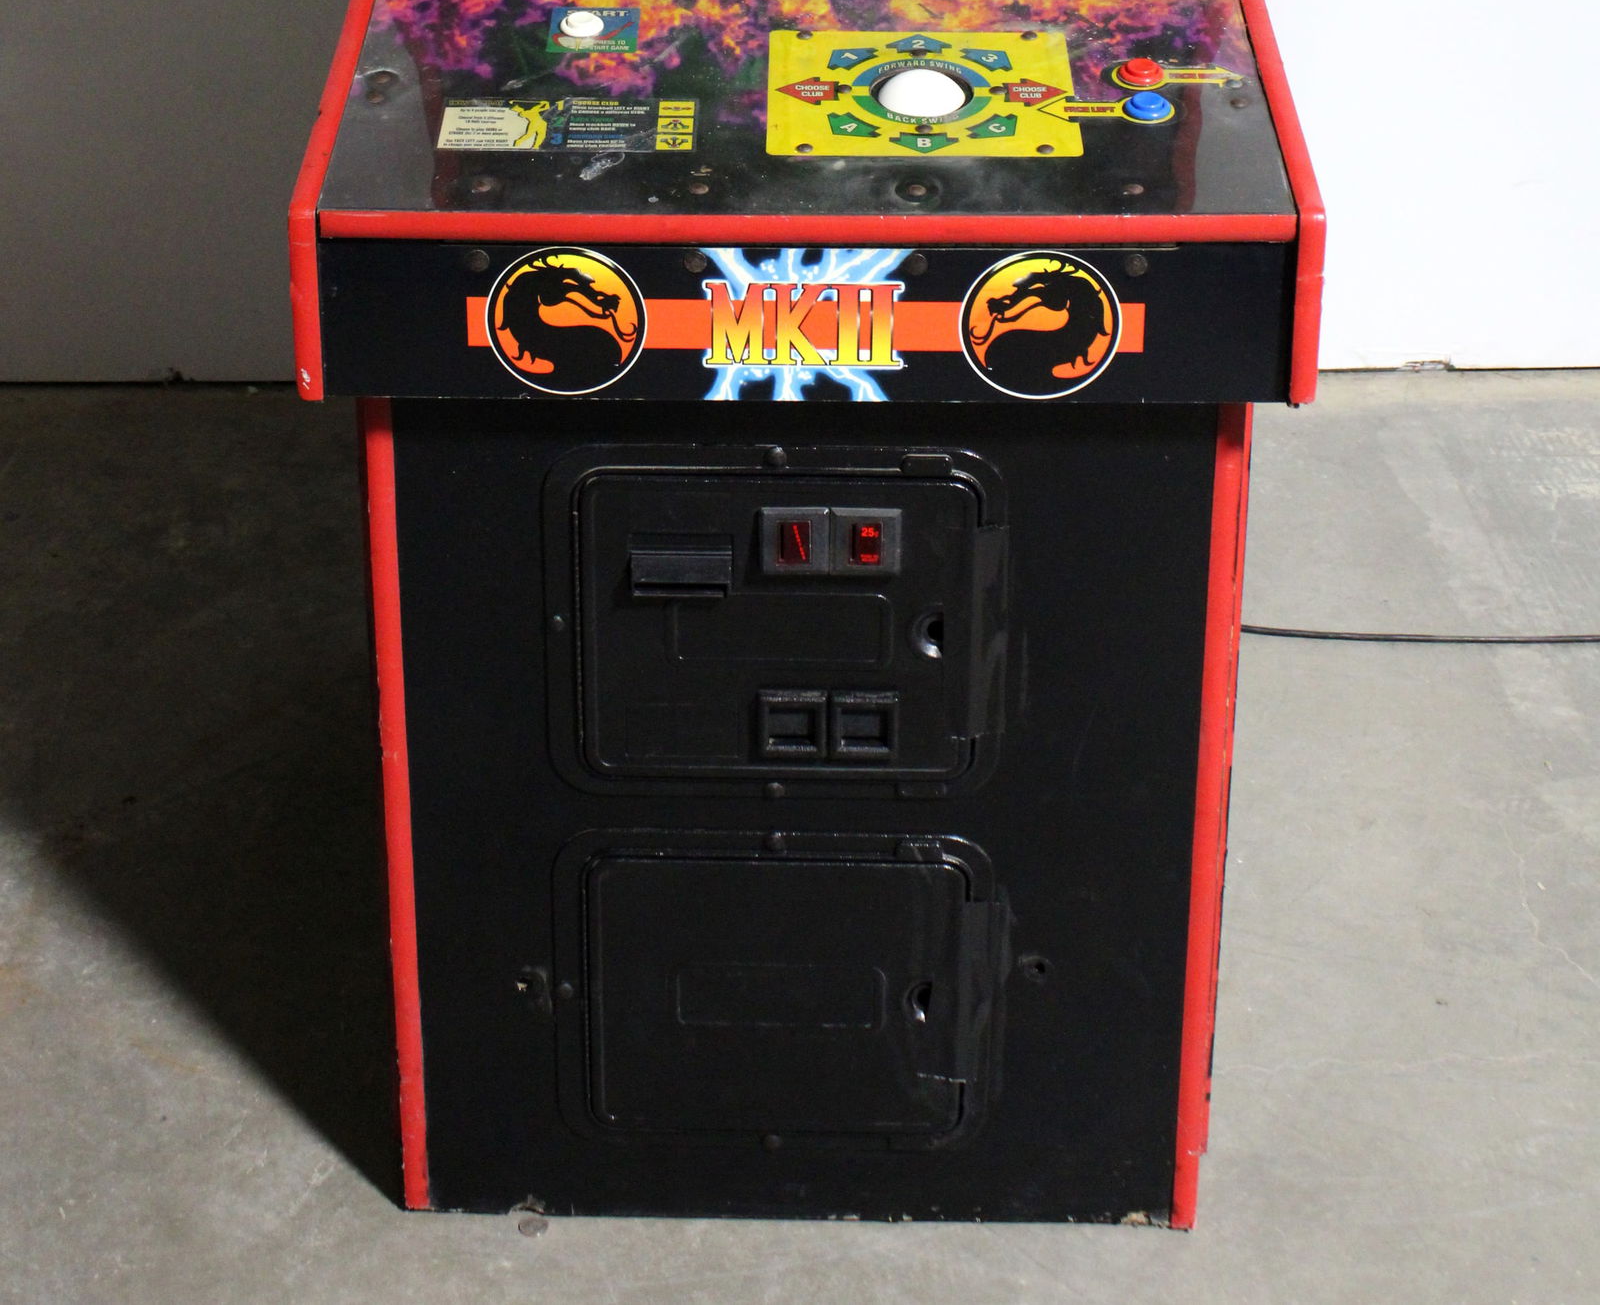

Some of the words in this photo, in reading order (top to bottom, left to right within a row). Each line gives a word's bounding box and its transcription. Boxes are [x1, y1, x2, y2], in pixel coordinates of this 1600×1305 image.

[566, 9, 629, 17] SART
[911, 39, 925, 49] 2
[841, 52, 858, 60] 1
[981, 53, 998, 63] 3
[878, 60, 926, 74] FORWARD
[929, 61, 962, 75] SWING
[555, 100, 565, 111] 1
[886, 112, 916, 124] BACK
[840, 122, 858, 132] A
[988, 123, 1006, 133] C
[551, 133, 563, 144] 3
[917, 138, 932, 148] B
[703, 280, 904, 368] MKII
